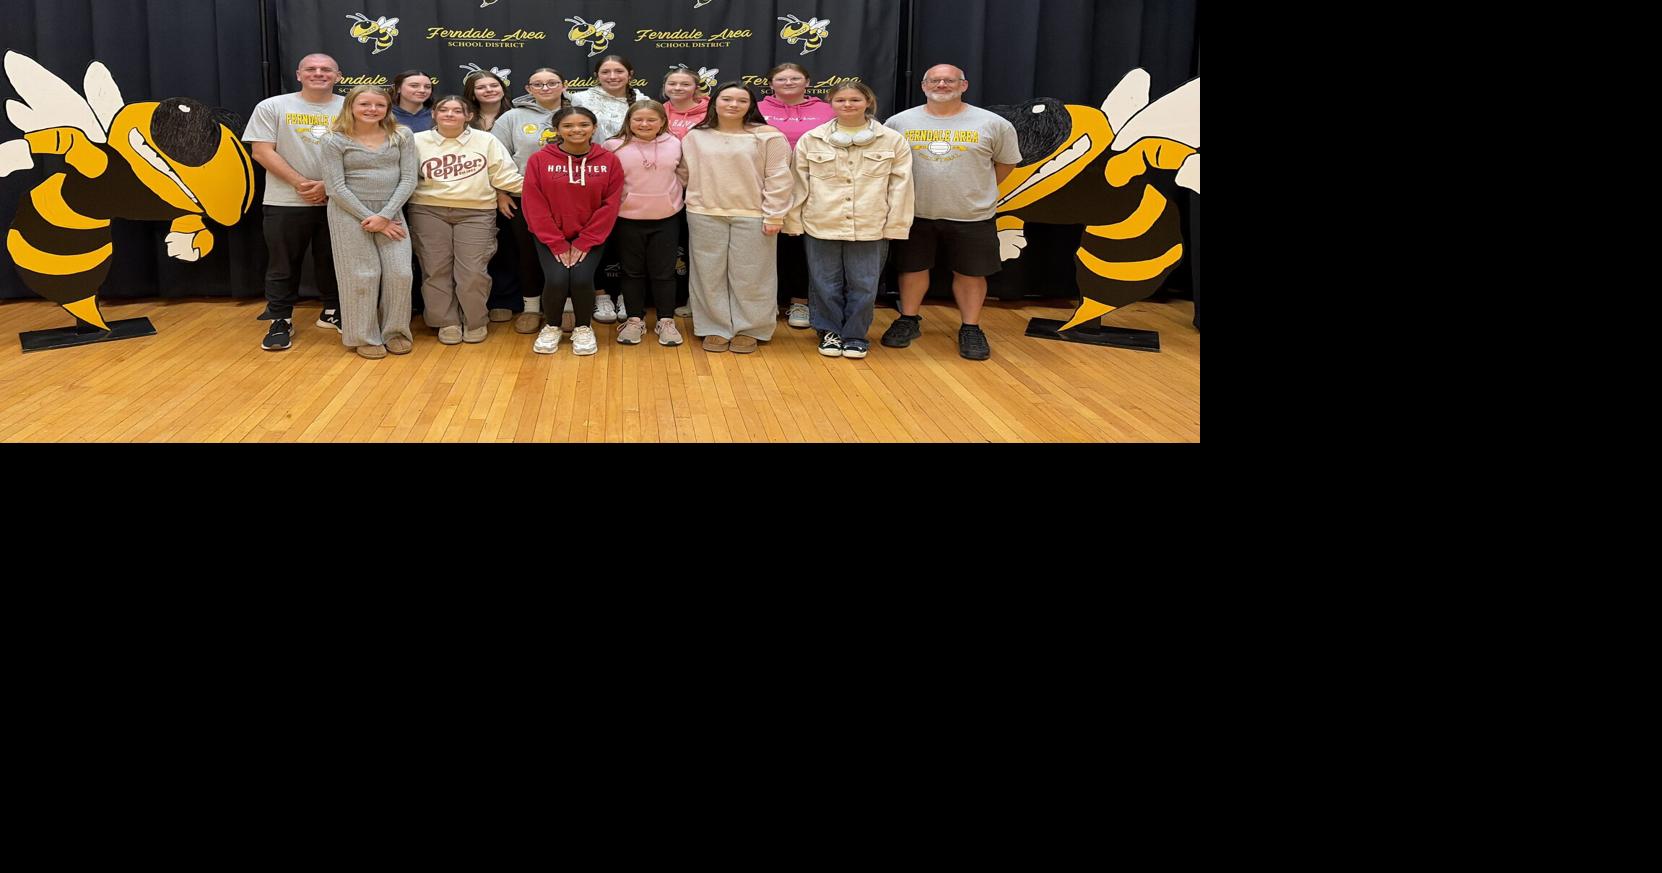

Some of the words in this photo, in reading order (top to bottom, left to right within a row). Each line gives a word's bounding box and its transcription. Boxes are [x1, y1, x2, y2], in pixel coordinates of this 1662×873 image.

[426, 27, 496, 39] Ferndale
[501, 29, 546, 42] Area
[634, 29, 704, 42] Ferndale
[707, 28, 753, 42] Area
[340, 74, 388, 85] rndale
[904, 129, 951, 142] FERNDALE
[953, 130, 979, 144] AREA
[421, 157, 482, 179] Pepper
[442, 153, 467, 168] Dr
[547, 164, 608, 173] HOLITER
